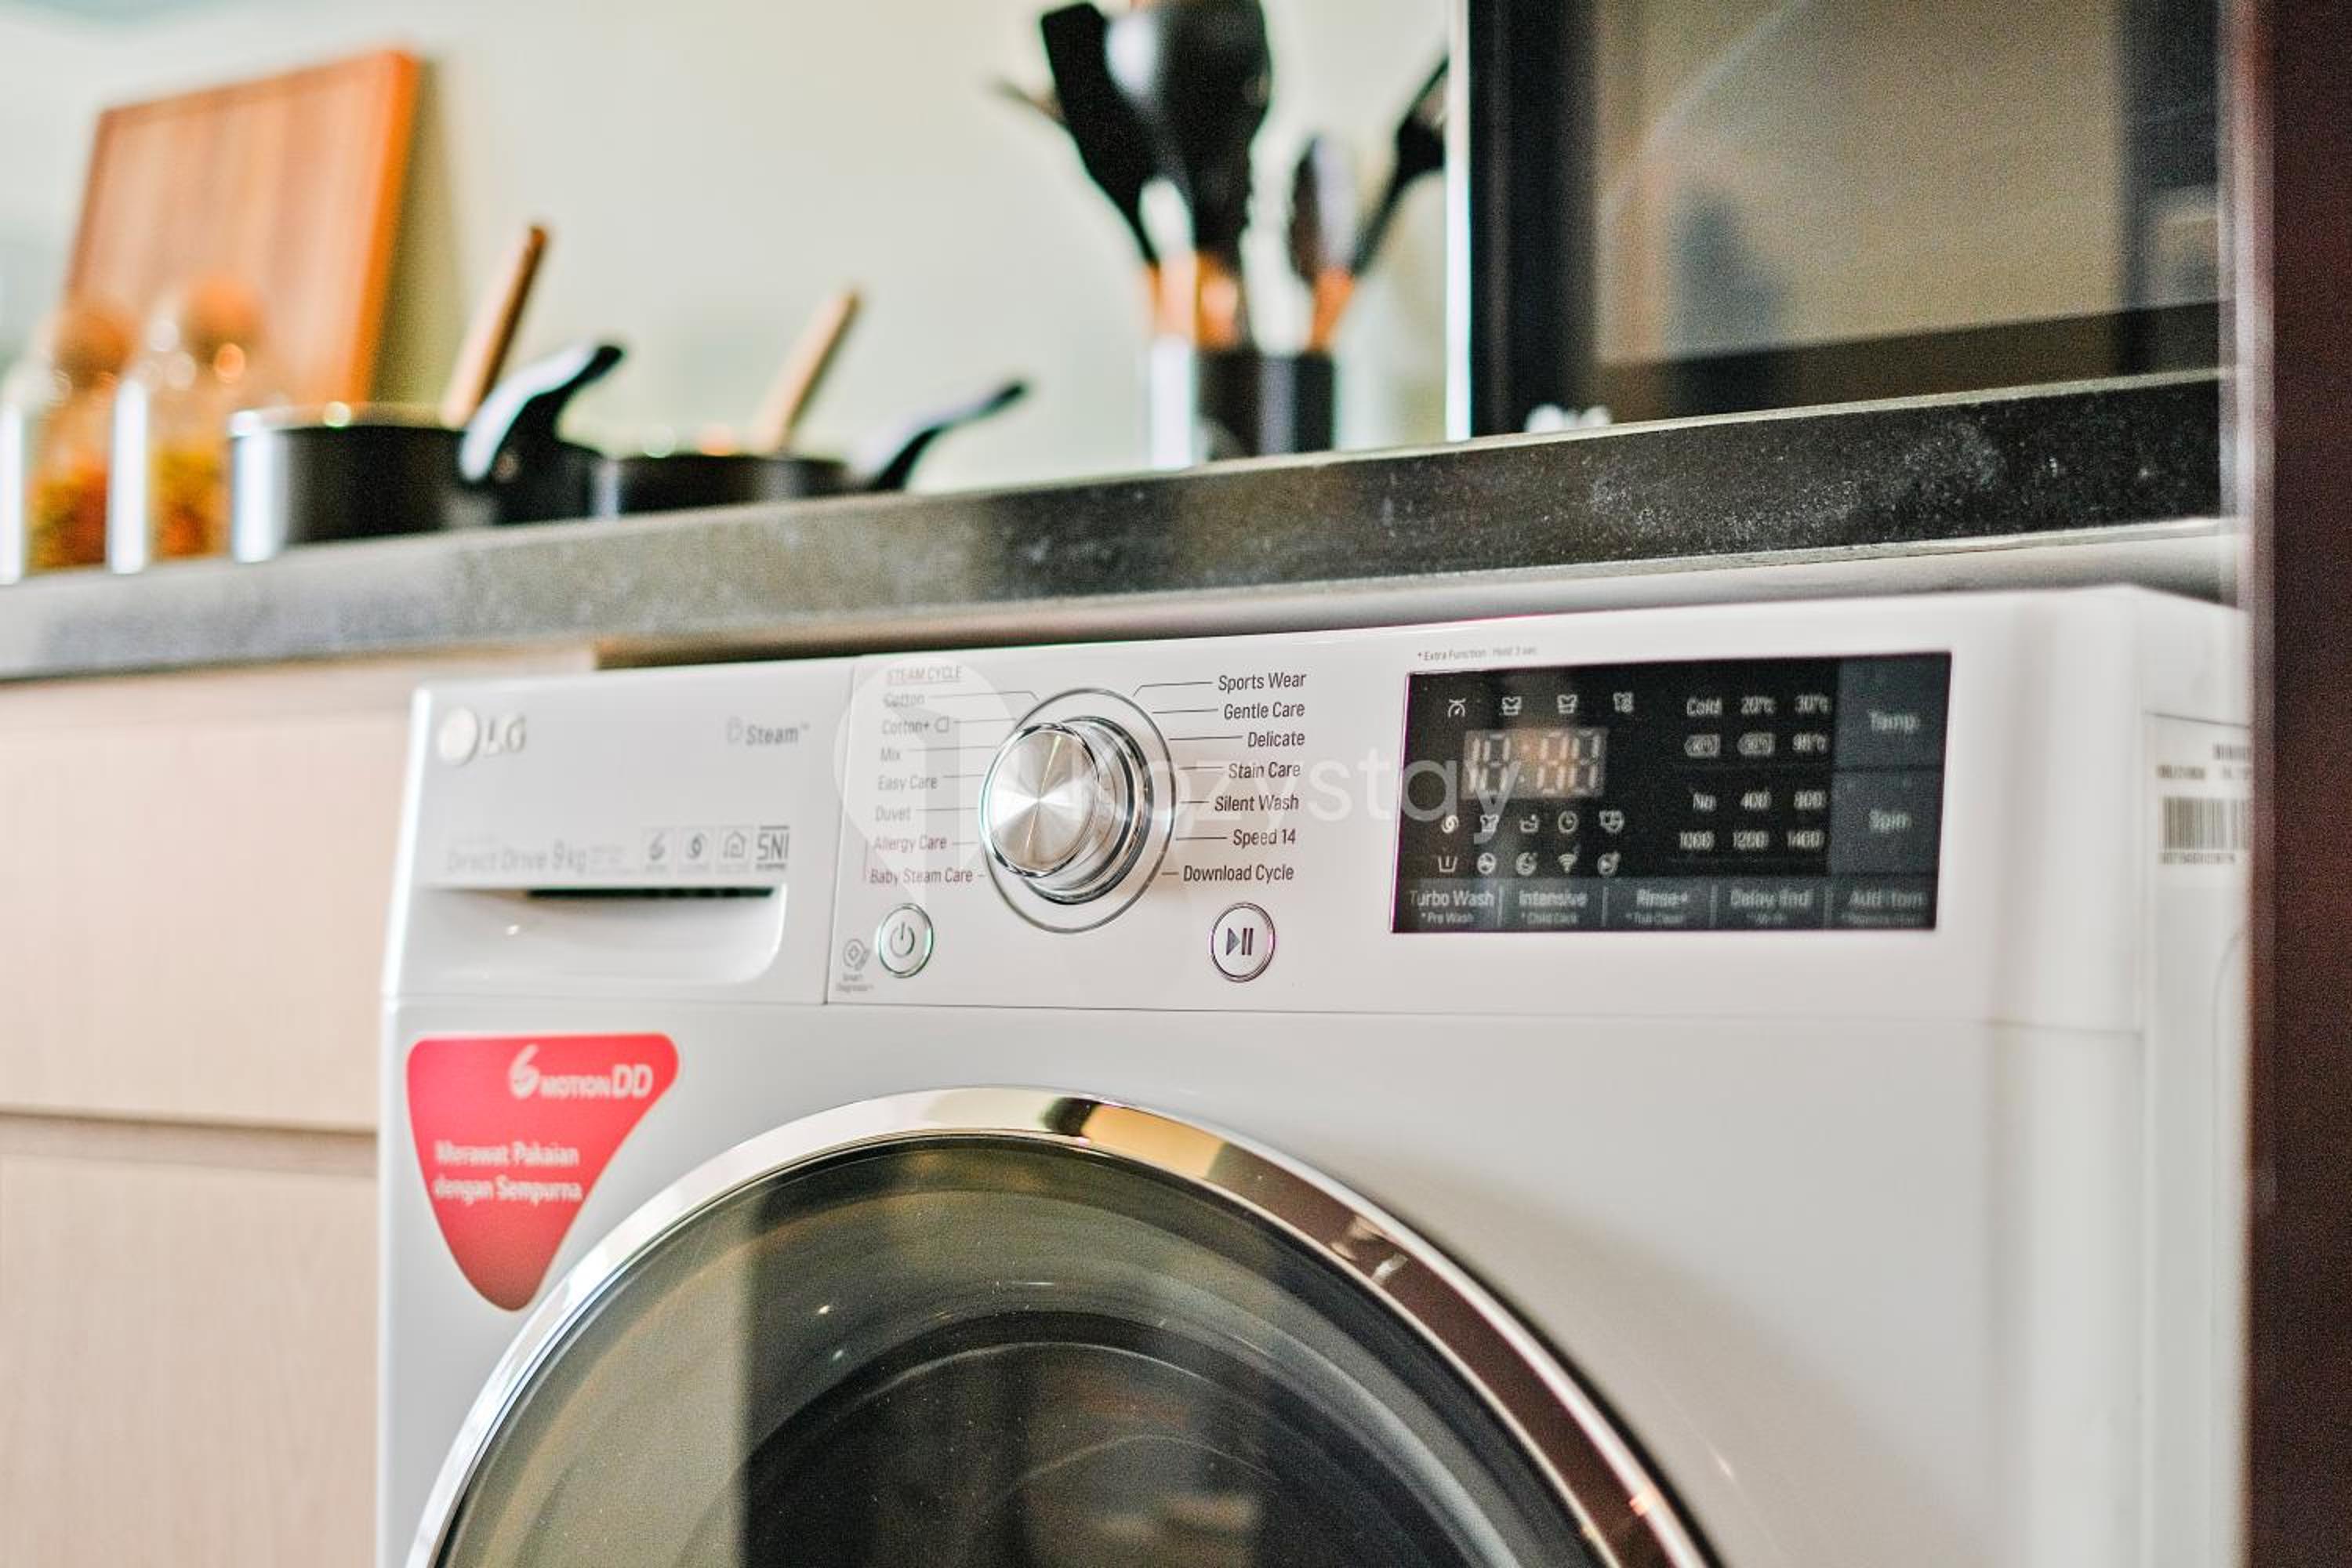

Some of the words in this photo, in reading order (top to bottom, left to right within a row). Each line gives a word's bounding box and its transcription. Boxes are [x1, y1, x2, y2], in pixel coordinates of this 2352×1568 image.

[887, 668, 926, 681] STEAM
[928, 666, 962, 680] CYCLE
[1218, 675, 1265, 693] Sports
[1268, 672, 1307, 688] Wear
[883, 693, 926, 706] Cotton
[1686, 696, 1723, 716] Cold
[1224, 704, 1269, 720] Gentle
[1272, 702, 1305, 717] Care
[881, 720, 929, 735] Cotton+
[1247, 731, 1305, 747] Delicate
[880, 747, 901, 761] Mix
[1229, 764, 1265, 779] Stain
[1268, 763, 1301, 778] Care
[878, 777, 908, 792] Easy
[910, 775, 938, 789] Care
[1214, 797, 1255, 811] Silent
[1258, 795, 1299, 810] Wash
[1693, 792, 1717, 812] No
[1740, 790, 1772, 810] 400
[875, 807, 911, 822] Duvet
[757, 832, 789, 860] SNI
[873, 837, 916, 854] Allergy
[919, 835, 947, 849] Care
[1232, 830, 1277, 848] Speed
[1281, 829, 1296, 844] 14
[1733, 829, 1769, 851] 1200
[1787, 829, 1824, 850] 1400
[870, 869, 899, 886] Baby
[903, 869, 942, 883] Steam
[945, 868, 973, 882] Care
[1183, 866, 1252, 881] Download
[1255, 865, 1294, 883] Cycle
[1409, 889, 1449, 907] Turbo
[1452, 889, 1495, 908] Wash
[1518, 889, 1588, 908] Intensive
[434, 1140, 508, 1166] Merawat
[512, 1140, 580, 1167] Pakaian
[434, 1174, 493, 1207] dengan
[496, 1174, 583, 1207] Sempurna
